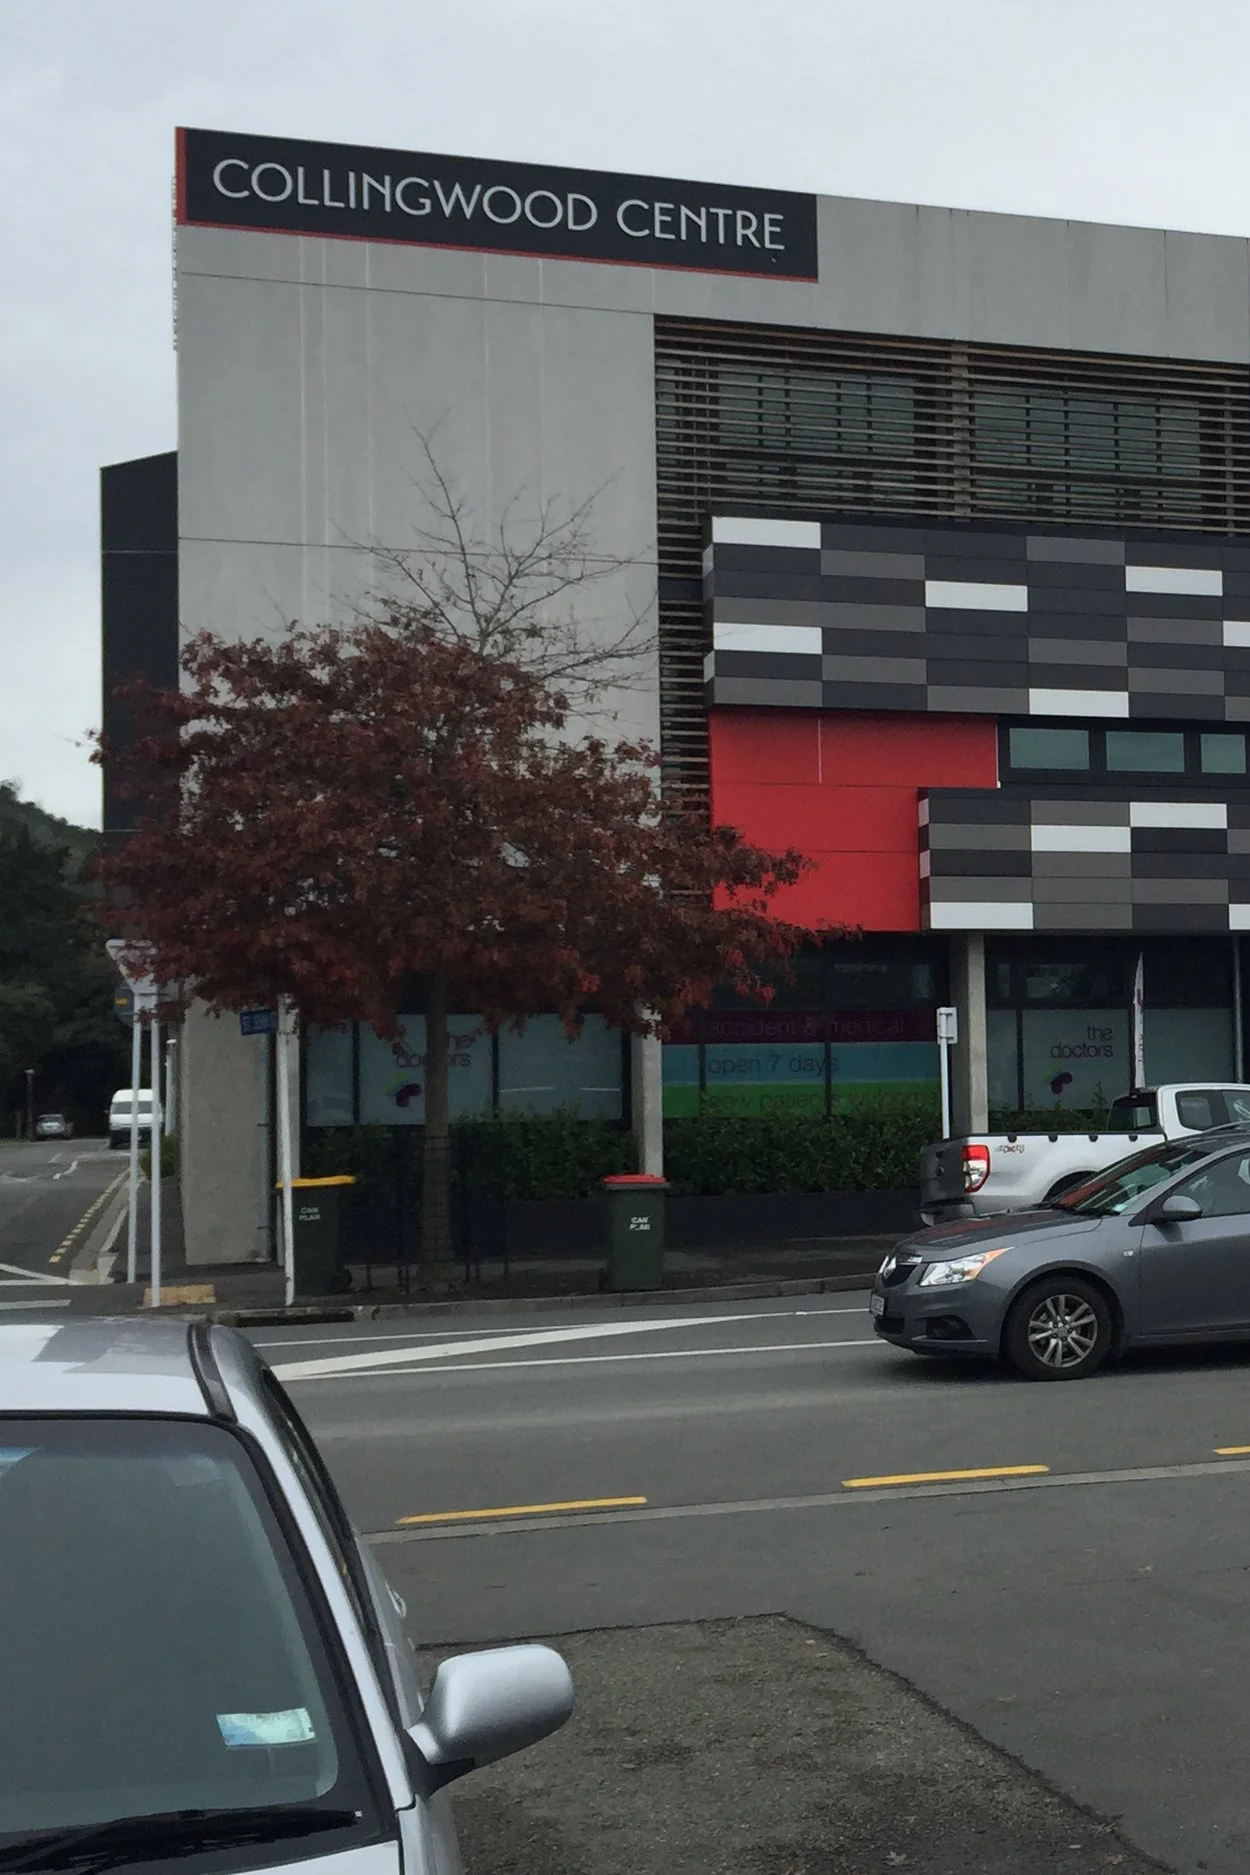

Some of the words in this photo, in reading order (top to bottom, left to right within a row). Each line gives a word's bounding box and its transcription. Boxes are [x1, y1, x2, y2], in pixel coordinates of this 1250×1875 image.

[212, 158, 598, 231] COLLINGWOOD
[616, 199, 785, 251] CENTRE
[1087, 1025, 1113, 1041] the
[1051, 1042, 1113, 1058] doctors
[708, 1056, 760, 1077] open
[769, 1053, 782, 1073] 7
